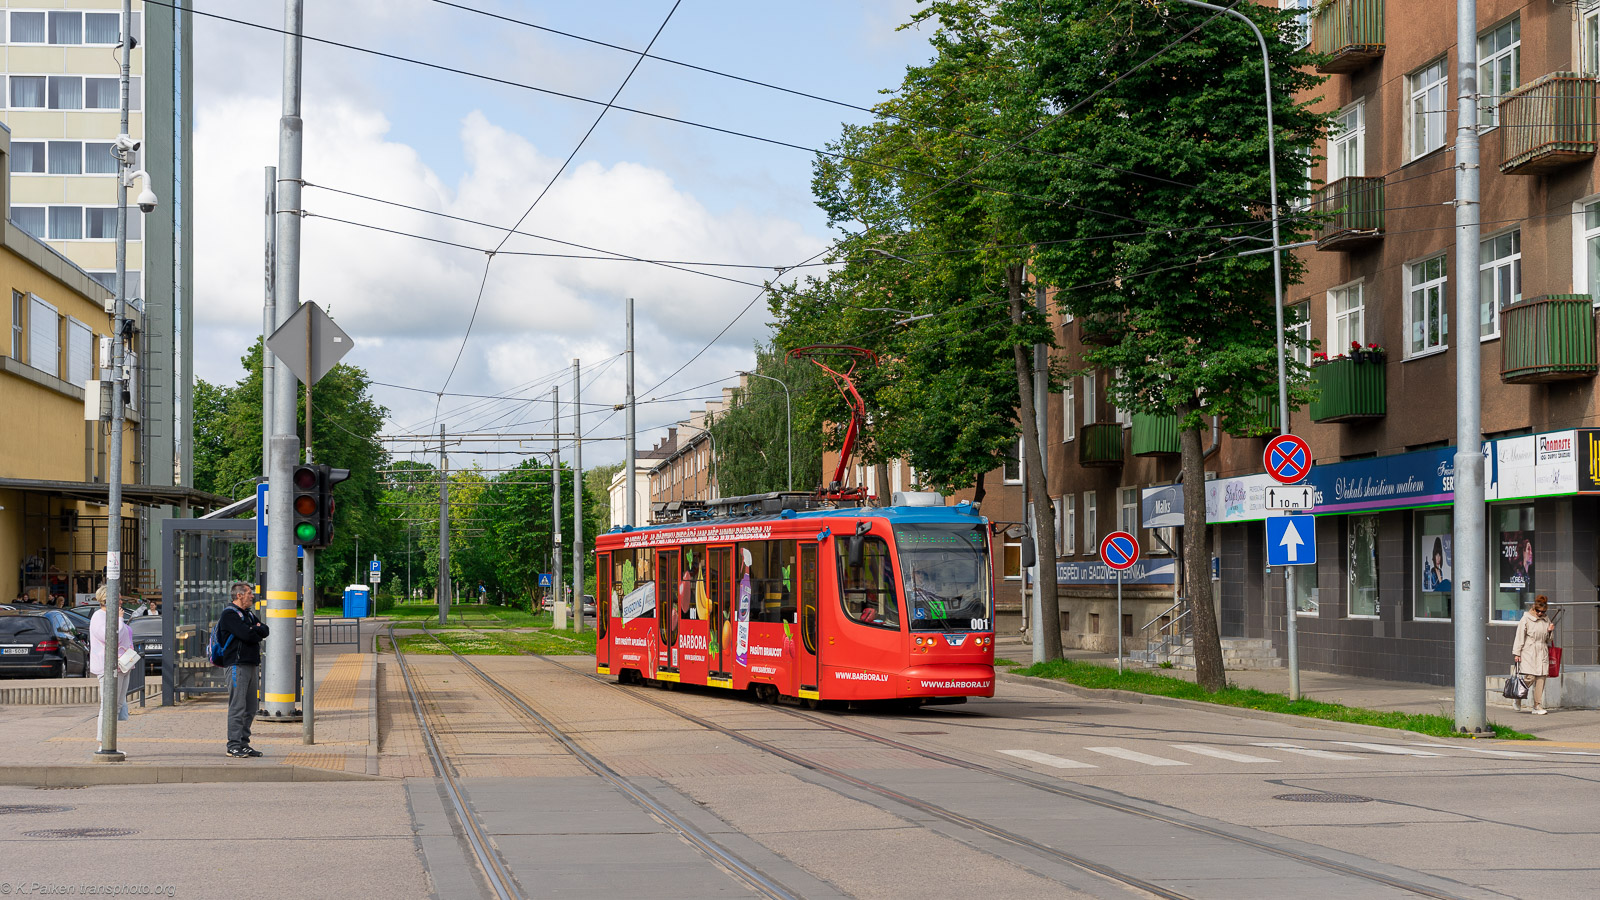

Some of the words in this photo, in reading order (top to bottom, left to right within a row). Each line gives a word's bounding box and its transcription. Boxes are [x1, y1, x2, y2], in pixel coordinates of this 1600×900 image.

[1546, 438, 1571, 451] NAMASTE
[1335, 477, 1363, 500] Veikals
[1363, 476, 1395, 497] skaistiem
[1396, 475, 1425, 493] matiem
[1279, 499, 1290, 508] 10
[1502, 545, 1518, 557] -20%
[372, 562, 379, 571] P
[1080, 568, 1088, 579] un
[971, 618, 989, 630] 001
[680, 635, 707, 649] BARBORA
[835, 672, 888, 682] WWW.BARBORA.LV
